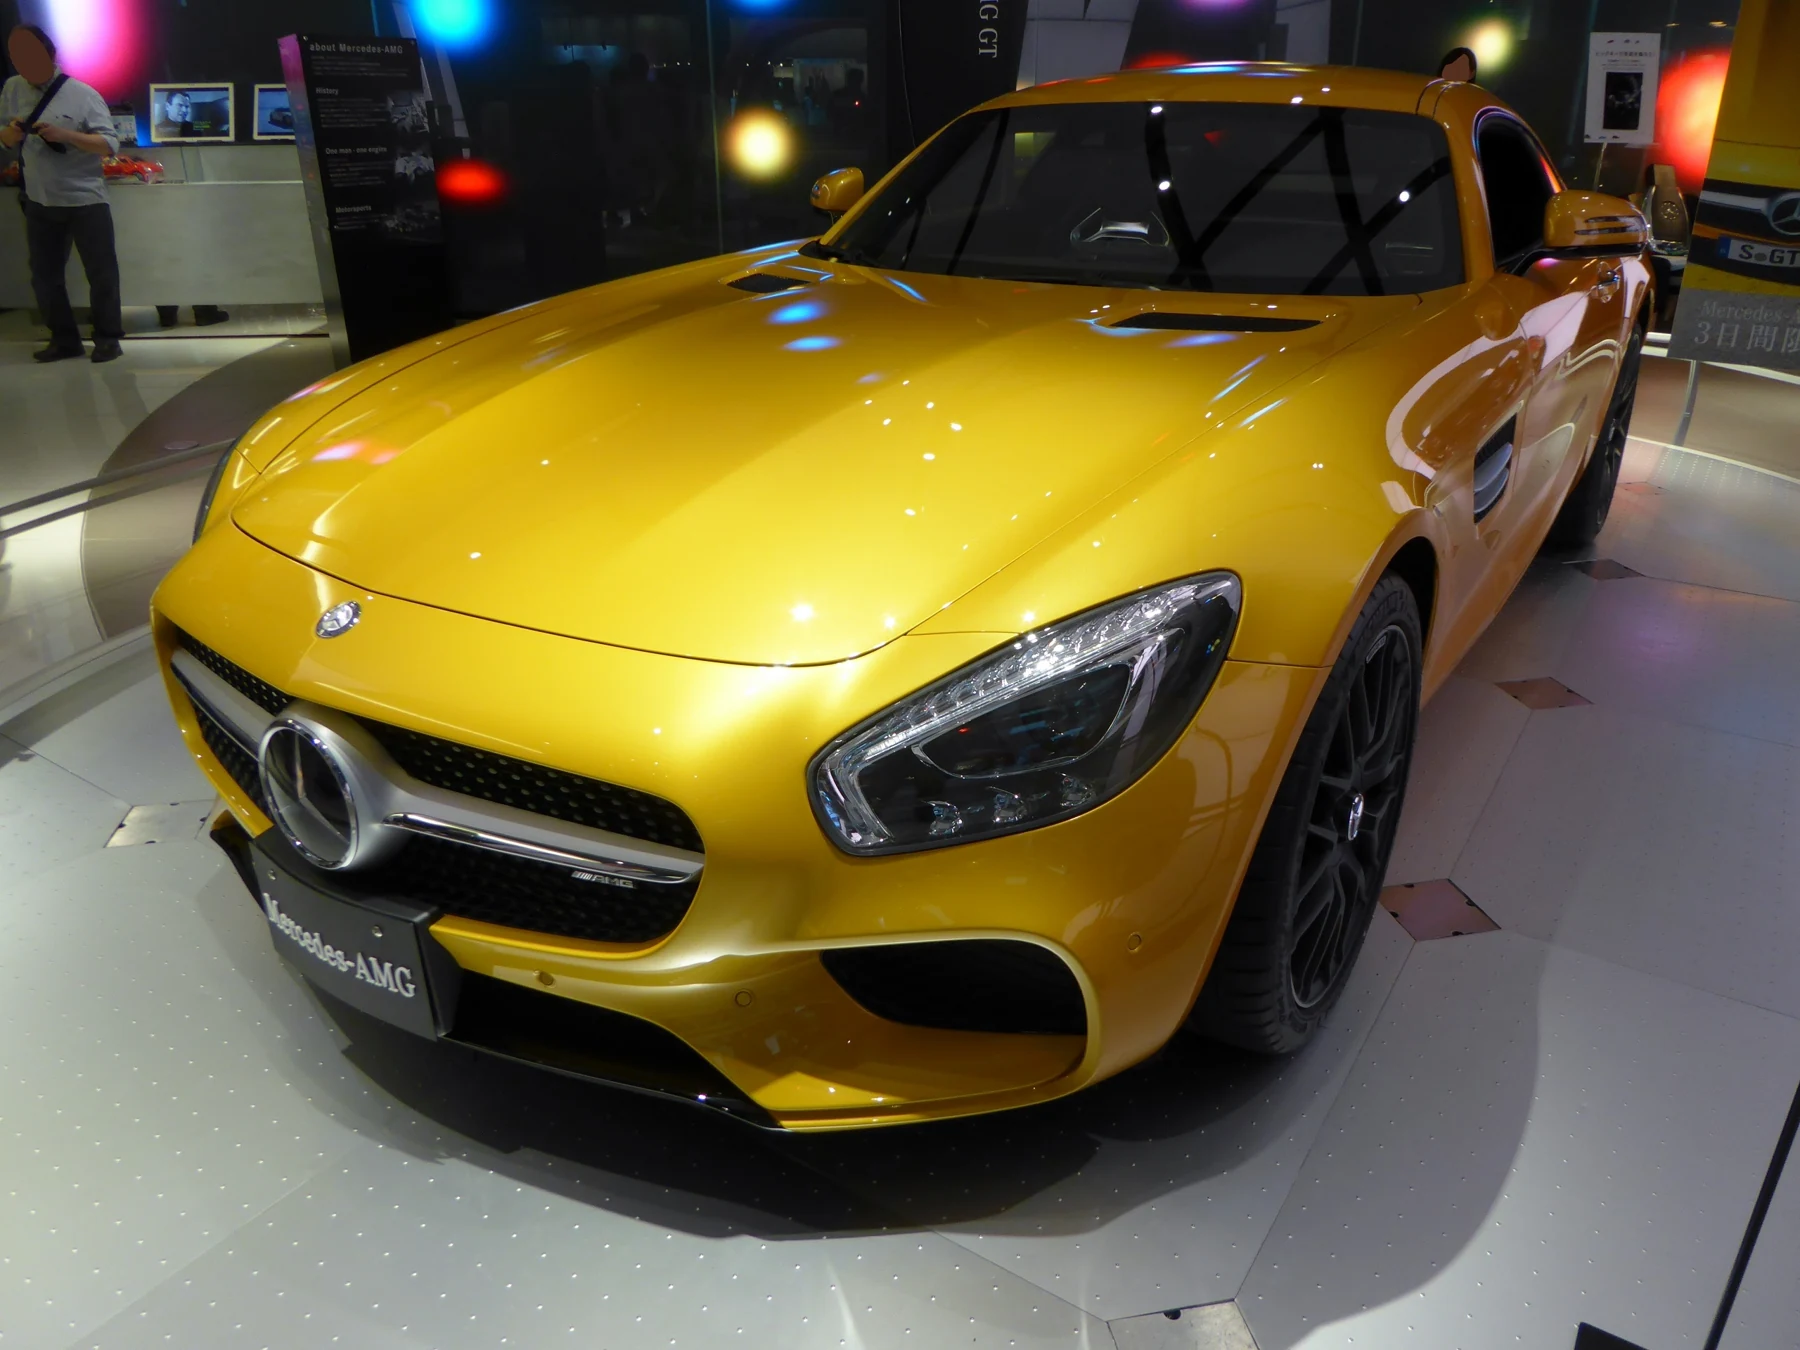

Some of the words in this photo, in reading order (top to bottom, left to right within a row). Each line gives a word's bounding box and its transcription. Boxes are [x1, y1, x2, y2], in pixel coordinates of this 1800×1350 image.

[979, 0, 999, 20] G
[309, 43, 336, 52] about
[339, 43, 403, 54] Mercedes-AMG
[978, 28, 998, 58] GT
[315, 87, 339, 96] History
[325, 147, 338, 155] One
[368, 146, 388, 155] engine
[335, 204, 372, 214] Motorsports
[590, 874, 634, 889] AMG
[262, 892, 416, 998] Mercedes-AMG
